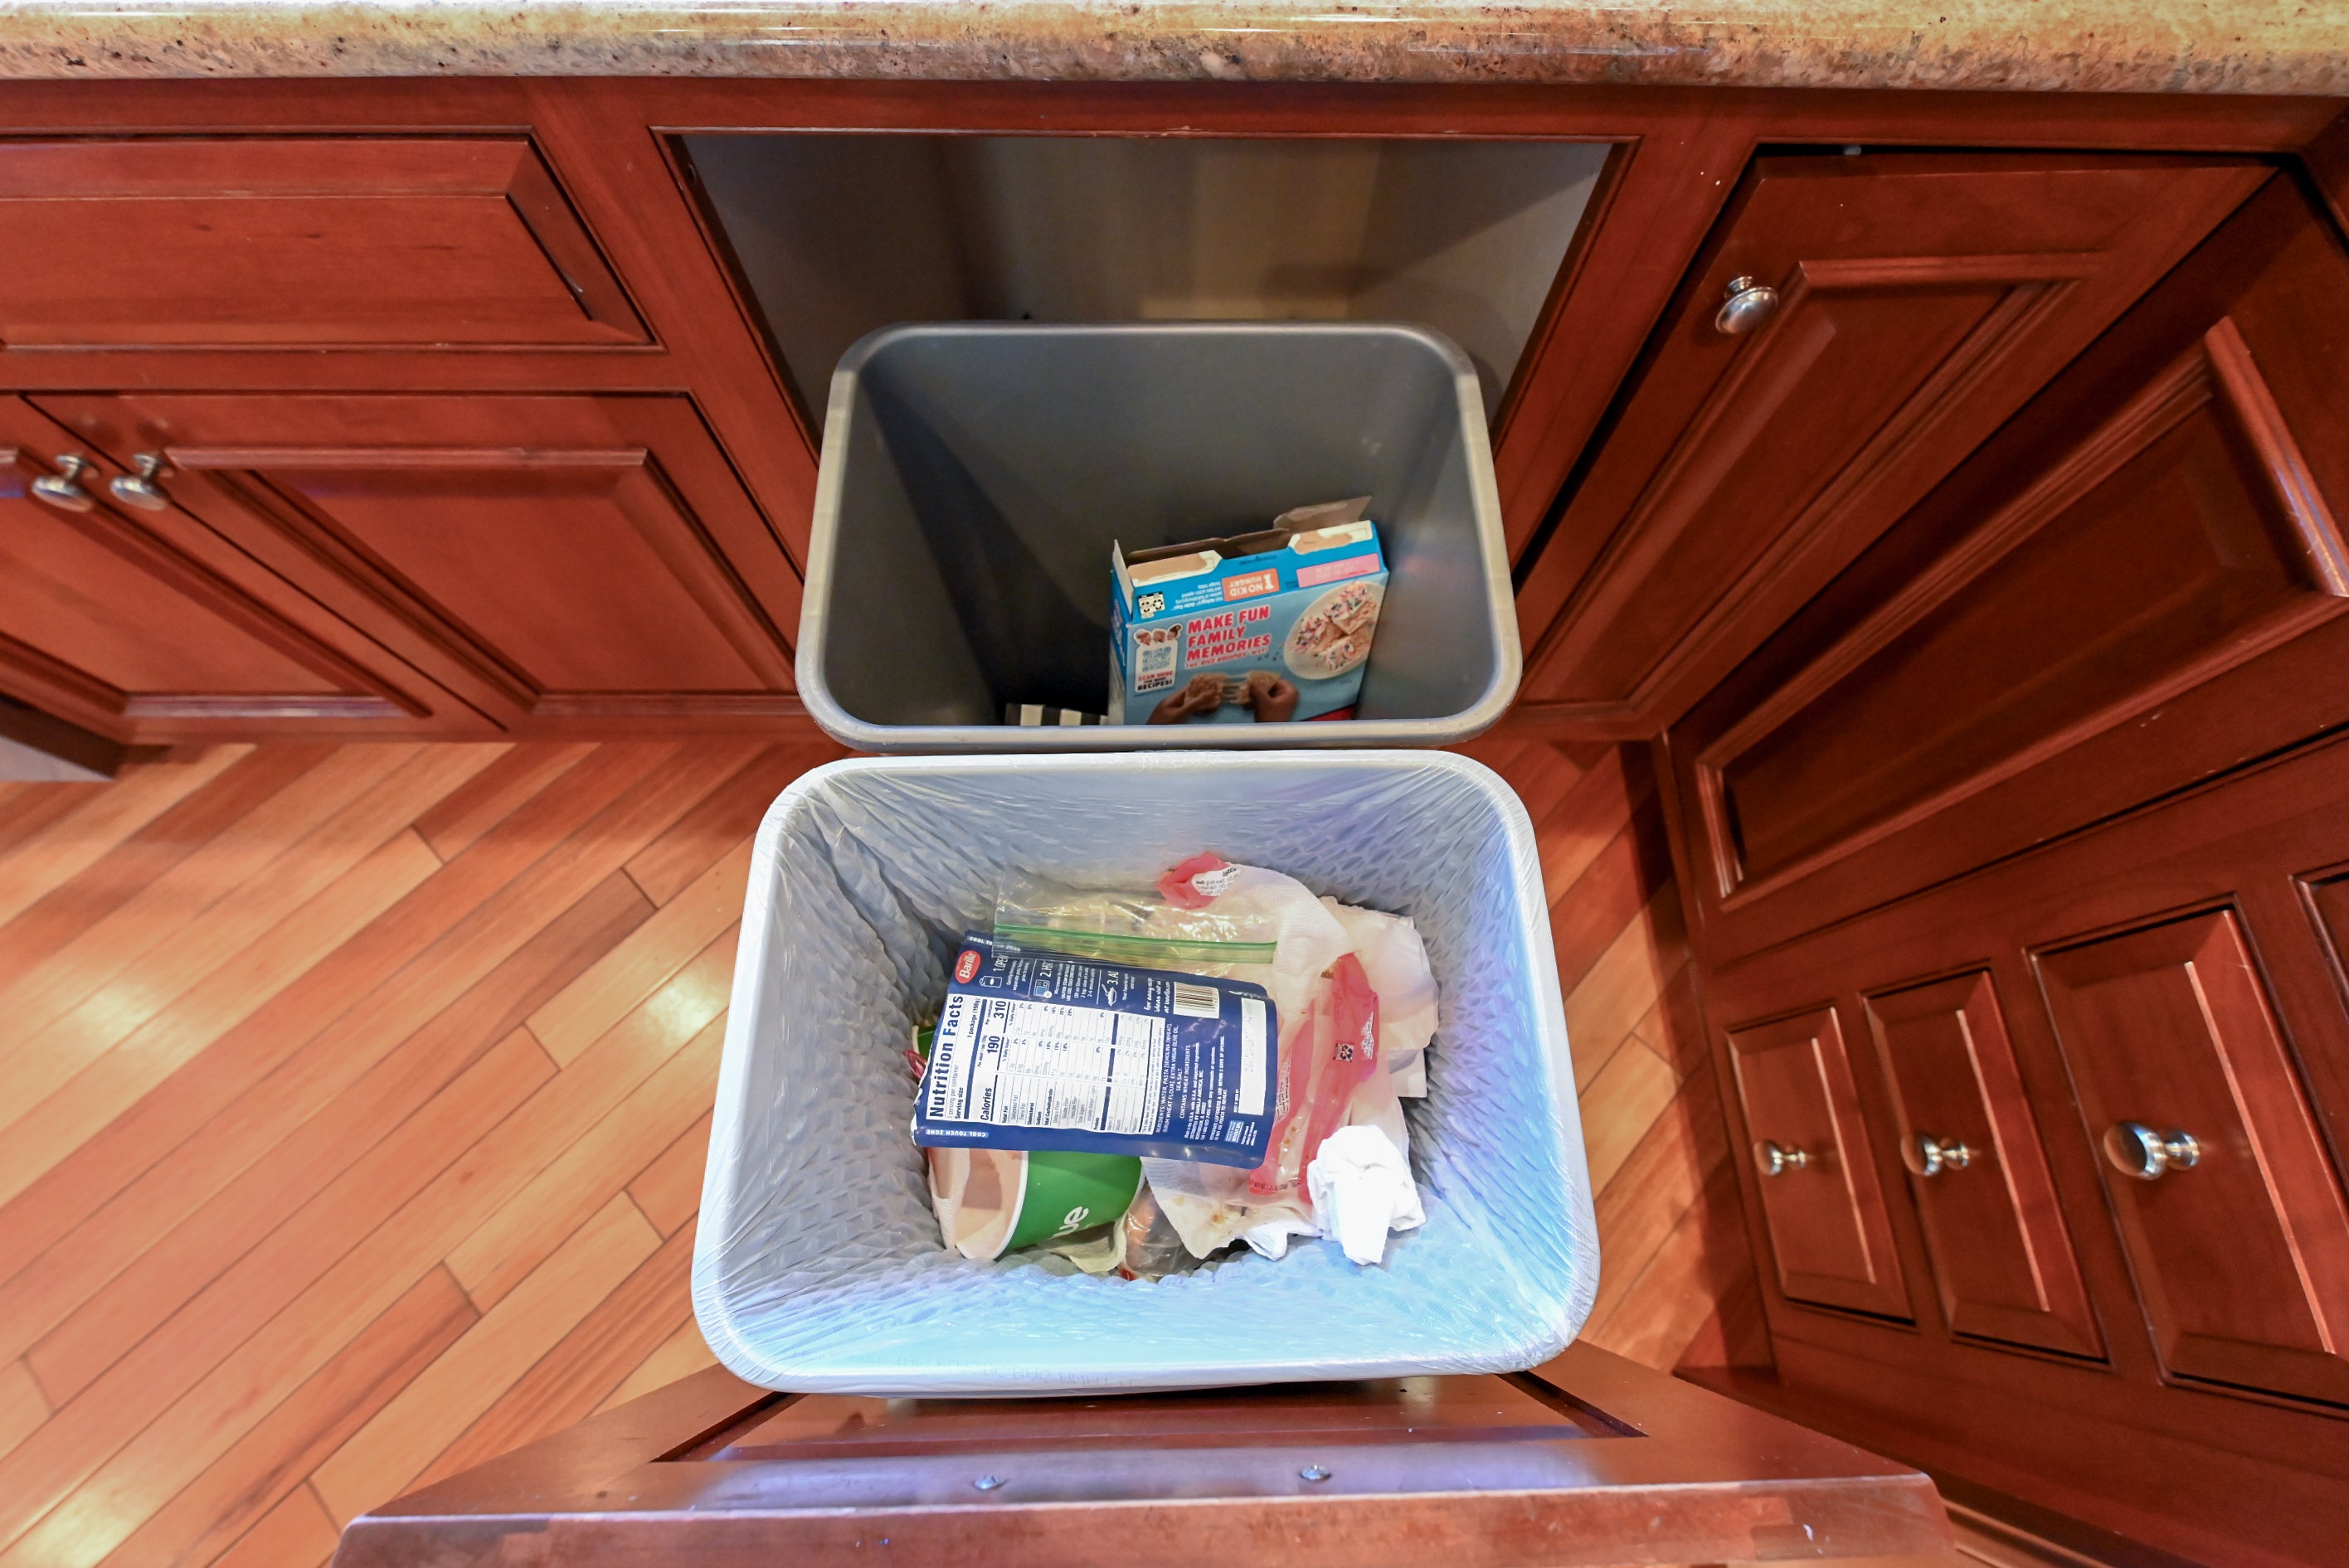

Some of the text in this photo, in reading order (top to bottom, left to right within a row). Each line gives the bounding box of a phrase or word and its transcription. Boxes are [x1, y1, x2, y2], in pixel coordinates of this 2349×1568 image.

[1229, 575, 1262, 588] HUNGRY
[1229, 583, 1262, 597] NO KID
[1188, 605, 1271, 634] MAKE FUN
[1188, 624, 1246, 648] FAMILY
[1186, 634, 1271, 662] MEMORIES
[1137, 680, 1172, 692] RECIPES!
[959, 952, 976, 978] Barilla
[993, 1000, 1006, 1018] 310
[968, 1014, 977, 1034] package
[986, 1036, 999, 1053] 190
[929, 1042, 953, 1117] Nutrition
[943, 995, 963, 1036] Facts
[955, 1099, 963, 1119] Serving
[980, 1087, 991, 1120] Calories
